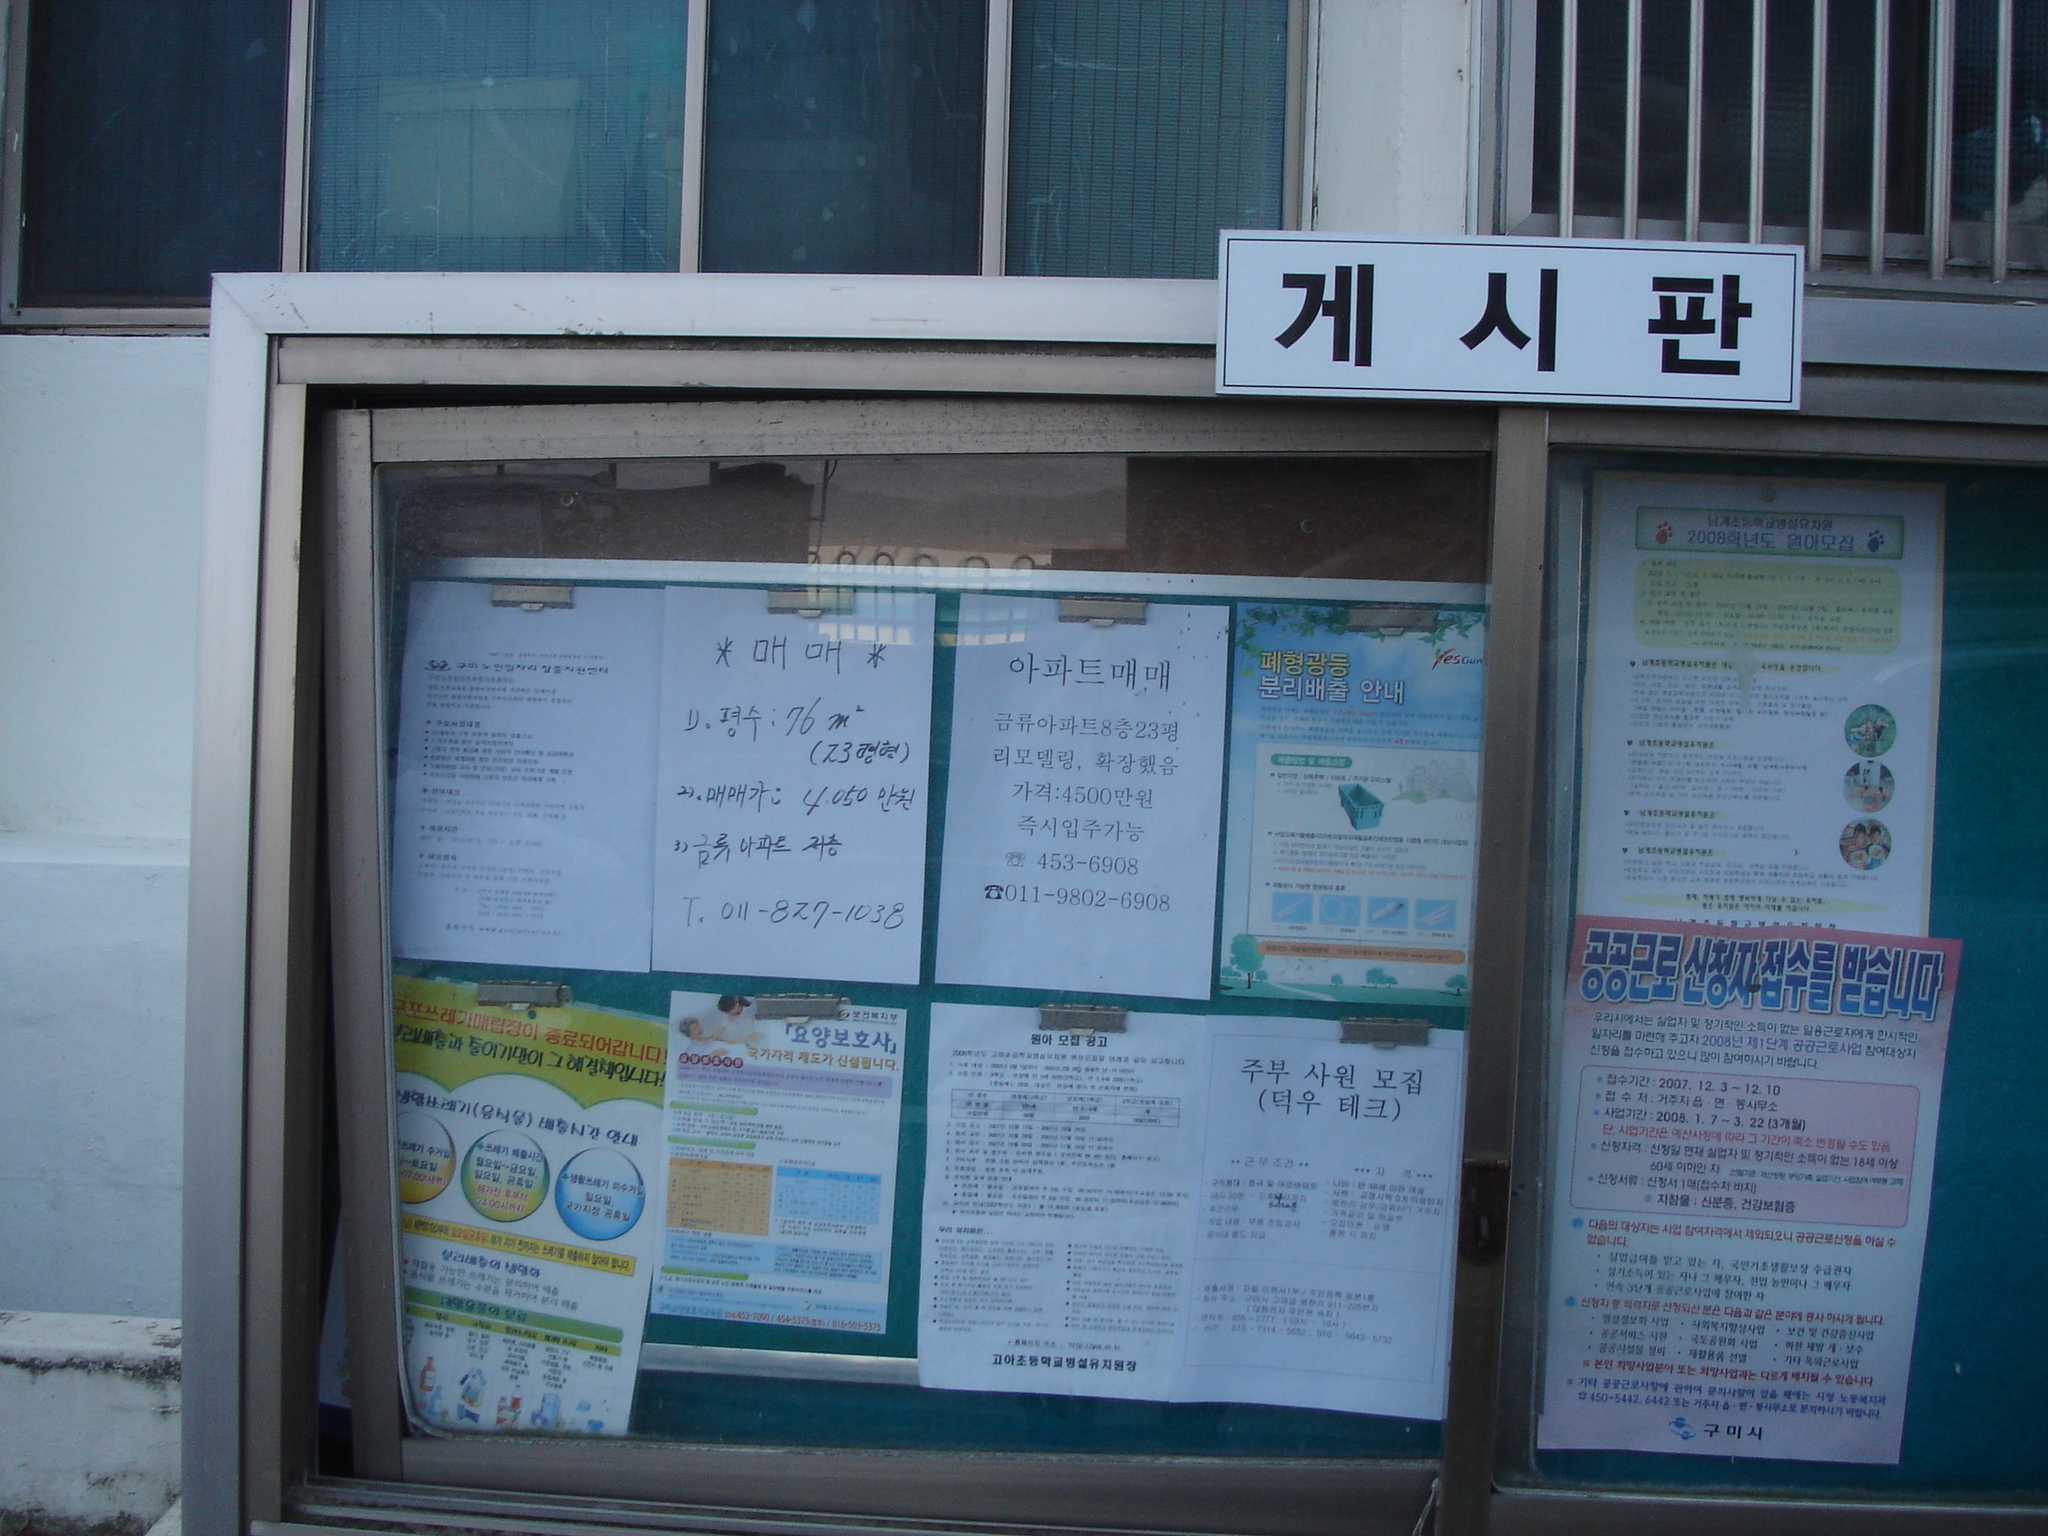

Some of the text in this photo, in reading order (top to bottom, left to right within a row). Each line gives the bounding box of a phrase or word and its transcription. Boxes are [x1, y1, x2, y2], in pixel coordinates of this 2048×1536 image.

[1688, 529, 1853, 552] 2008학년도 원아모집
[1009, 652, 1171, 692] 아파트매매
[1259, 650, 1350, 677] 폐형광등
[1259, 675, 1405, 705] 분리배출 안내
[786, 696, 822, 737] 76
[994, 713, 1178, 742] 금류아파트8층23평
[993, 746, 1178, 776] 리모델링, 확장했음
[877, 783, 915, 813] 만원
[1011, 781, 1153, 809] 가격:4500만원
[1018, 815, 1144, 842] 즉시입주가능
[739, 834, 792, 861] 아파트
[1037, 853, 1139, 875] 453-6908
[1005, 884, 1170, 912] 011-9802-6908
[720, 898, 906, 930] 011-827-1038
[1581, 928, 1944, 1022] 공공근로 신청자 접수를 받습니다
[1594, 1011, 1918, 1043] 우리시에서는 실업자 및 정기적인 소득이 없는 일용근로자에게 한시적인
[546, 1026, 667, 1064] 종료되어갑니다!
[1030, 1034, 1108, 1048] 원아 모집 공고
[1592, 1028, 1916, 1059] 일자리를 마련해 주고자 2008년 제1단계 공공근로사업 참여대상자
[547, 1051, 562, 1068] 그
[748, 1047, 899, 1072] 국가자격 제도가 신설됩니다.
[1590, 1045, 1819, 1069] 신청을 접수하고 있으니 많이 참여하시기 바랍니다.
[1241, 1059, 1423, 1096] 주부 사원 모집
[1606, 1073, 1650, 1088] 접수기간
[1658, 1077, 1692, 1091] 2007.
[1697, 1080, 1716, 1092] 12.
[1744, 1083, 1763, 1096] 12.
[1767, 1084, 1781, 1097] 10
[1258, 1089, 1401, 1121] (덕우 테크)
[1657, 1092, 1779, 1113] 거주지 동사무소
[1603, 1107, 1807, 1132] 사업기간 2008. 22 (3개월)
[1650, 1143, 1681, 1156] 신청일
[1684, 1145, 1704, 1157] 현재
[1707, 1147, 1738, 1159] 실업자
[1754, 1150, 1794, 1163] 정기적인
[1854, 1157, 1875, 1168] 18세
[1878, 1159, 1898, 1170] 이상
[1650, 1161, 1706, 1174] 60세 이하인
[1657, 1192, 1796, 1213] 지참물 신분증, 건강보험증
[1587, 1233, 1628, 1247] 없습니다.
[1588, 1219, 1793, 1241] 다음의 대상자는 사업 제외되오니
